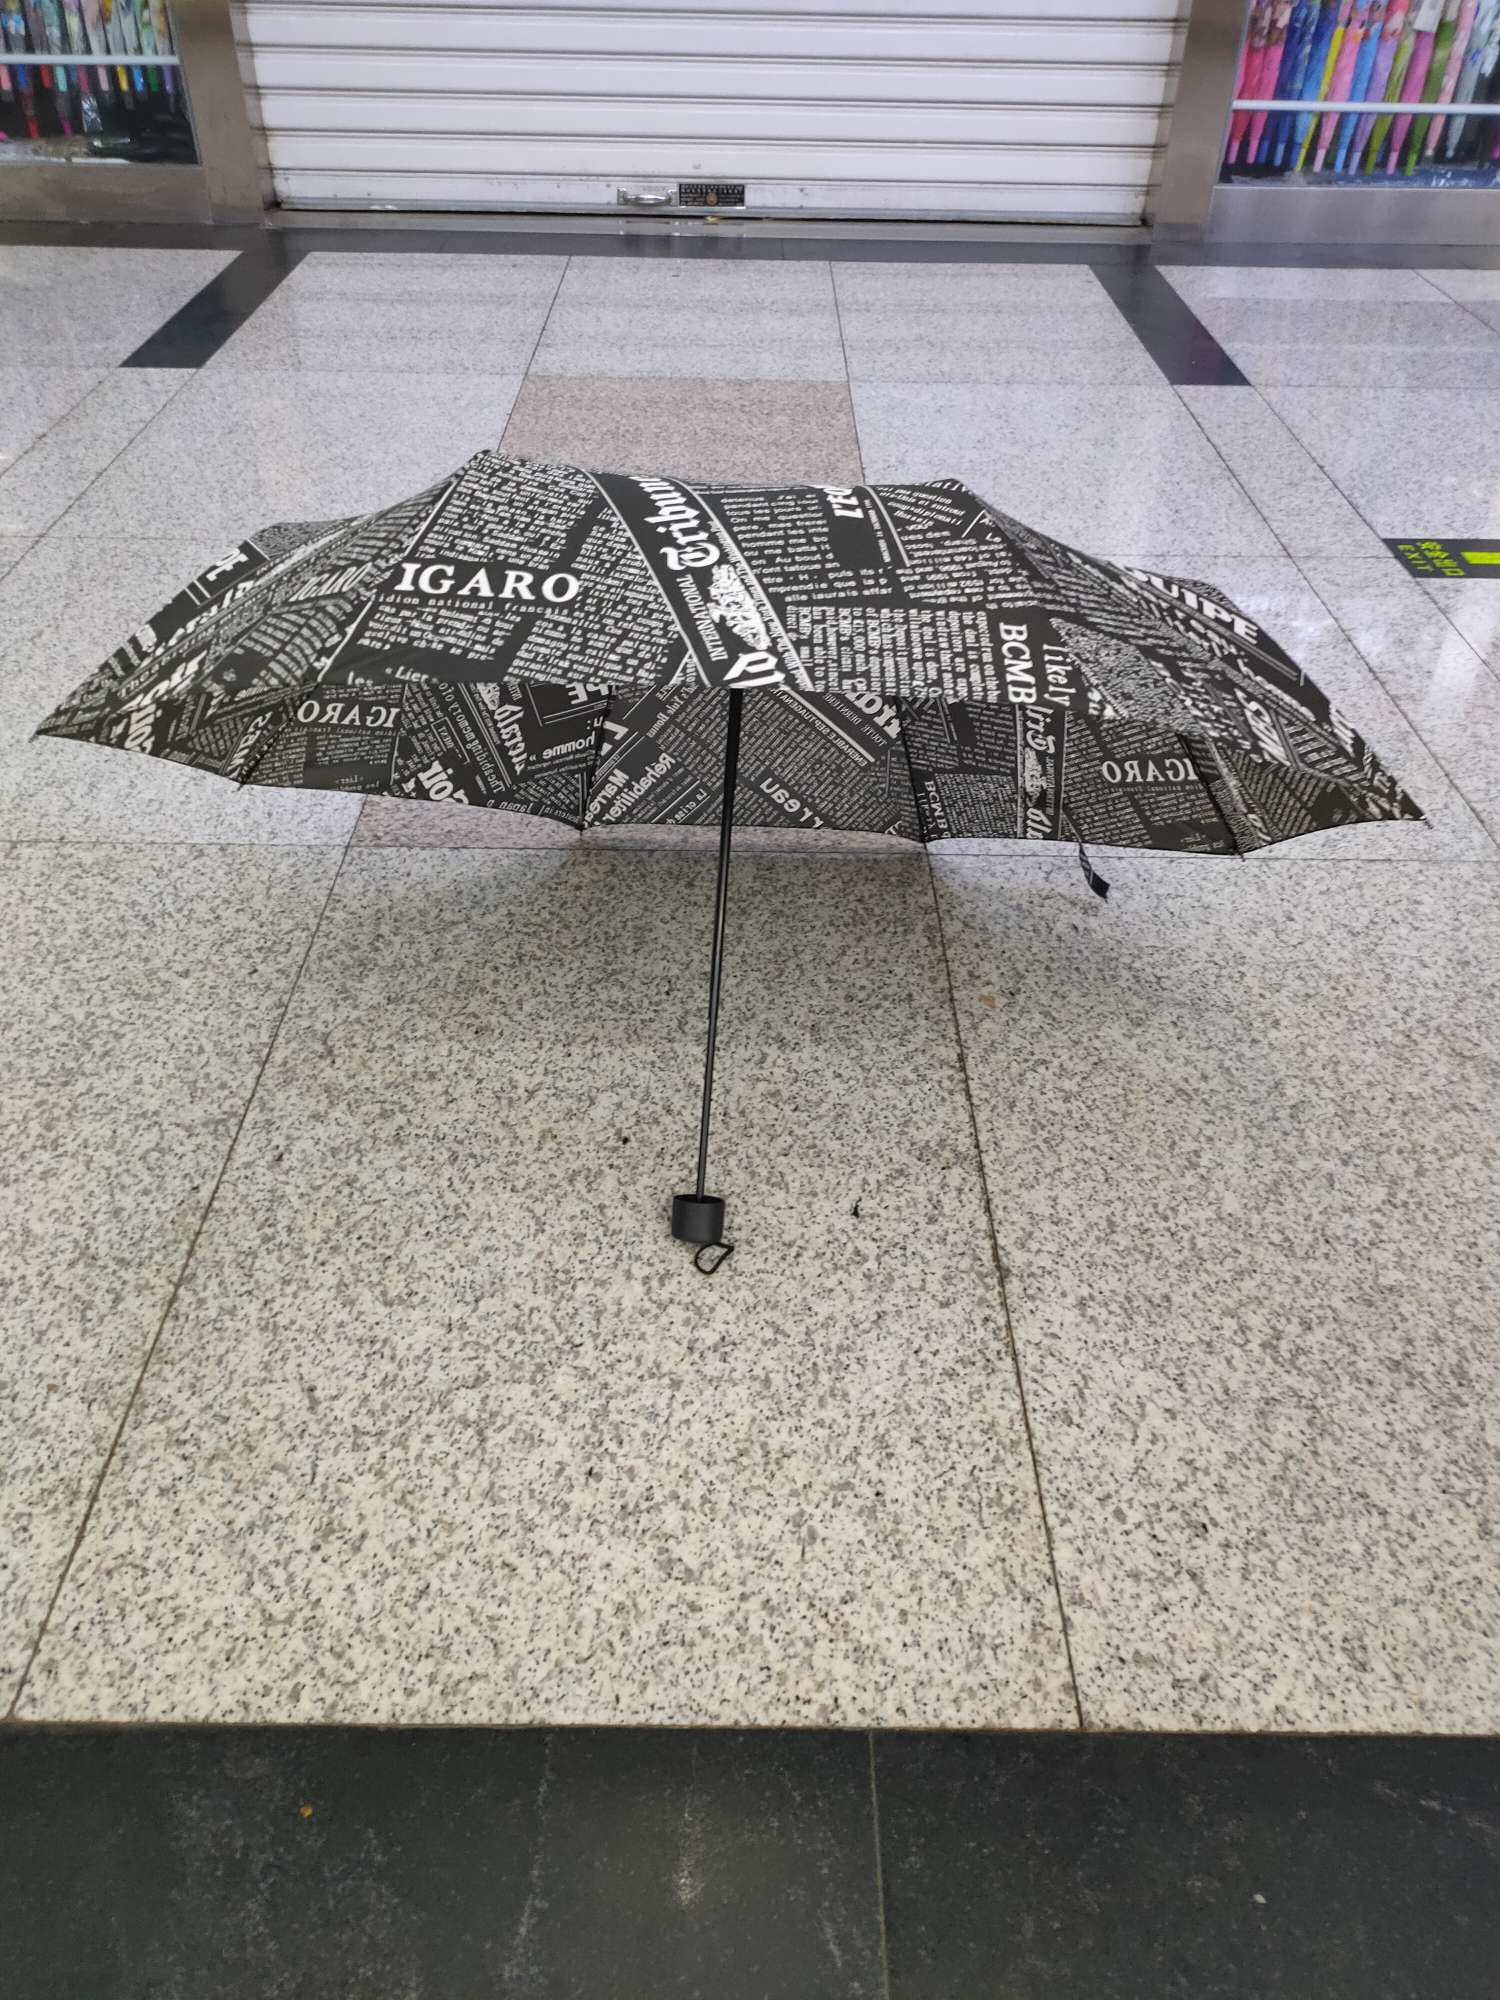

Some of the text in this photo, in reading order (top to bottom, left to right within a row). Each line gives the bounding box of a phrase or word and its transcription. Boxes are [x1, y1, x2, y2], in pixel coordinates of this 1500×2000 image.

[394, 563, 579, 603] IGARO
[676, 574, 729, 661] INTERNATIONAL
[999, 622, 1037, 703] BCMB
